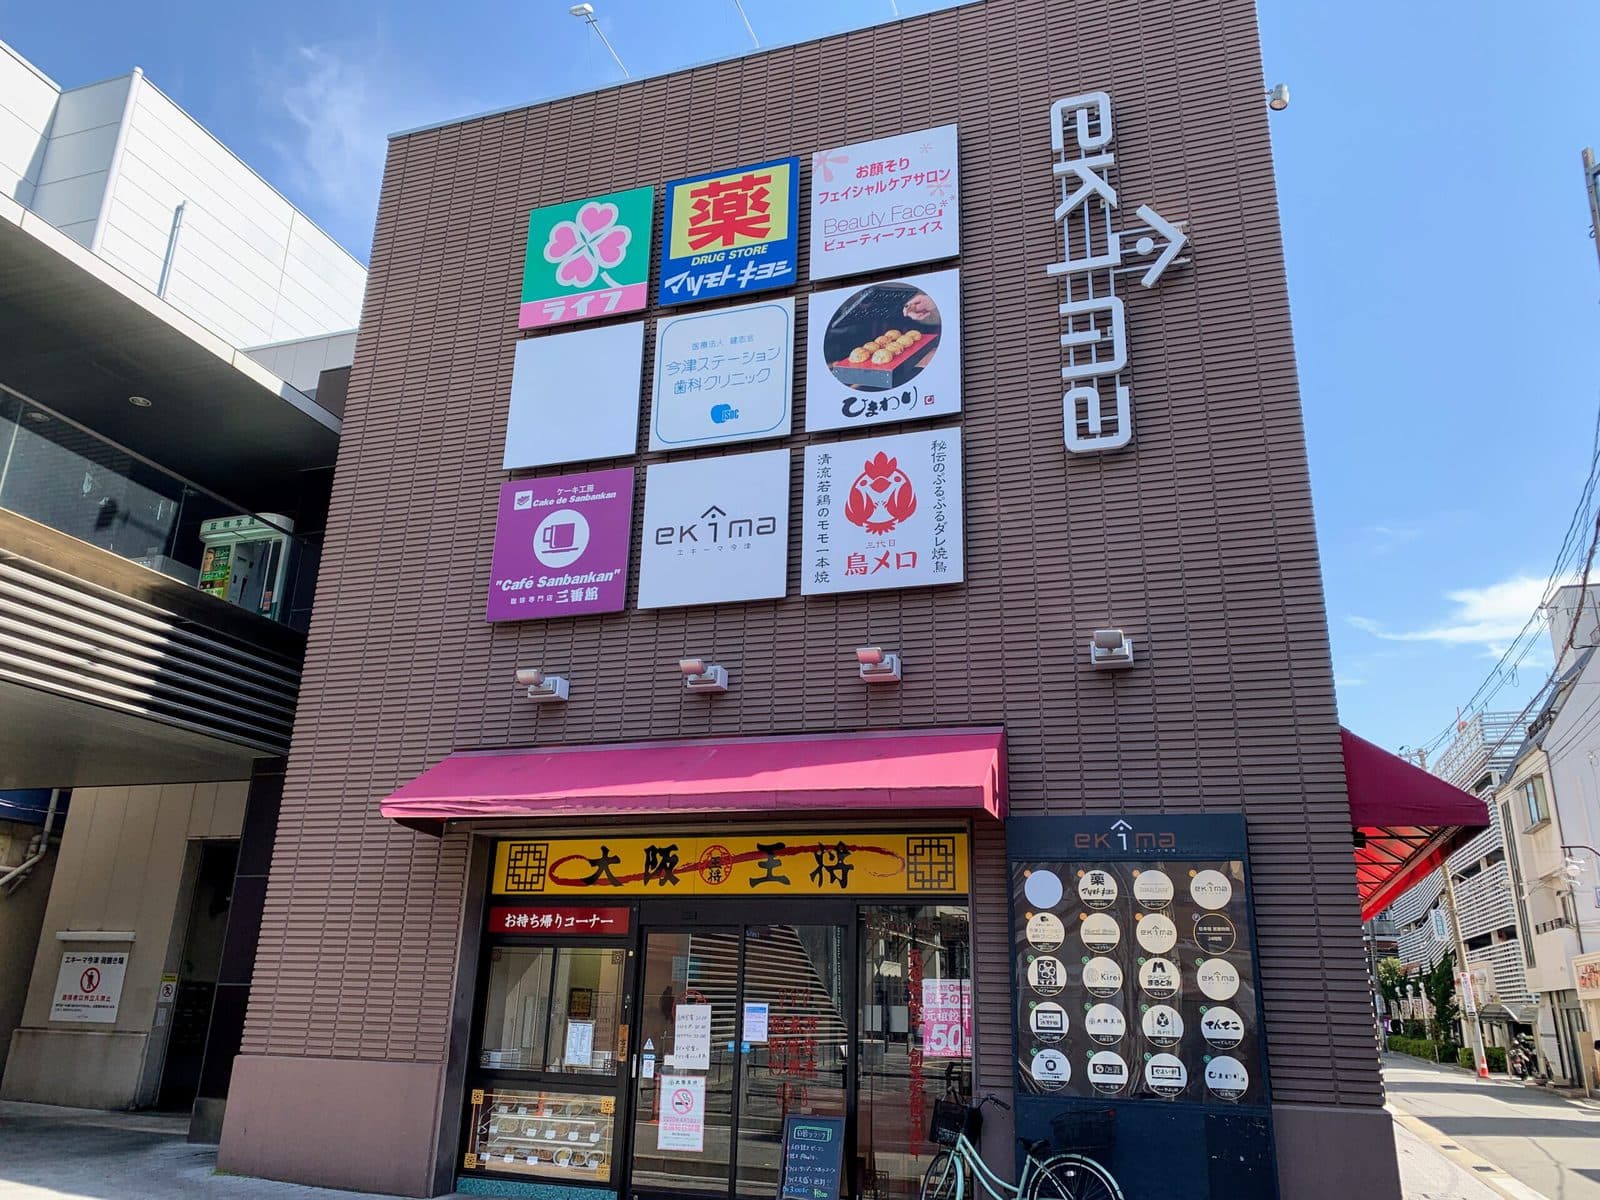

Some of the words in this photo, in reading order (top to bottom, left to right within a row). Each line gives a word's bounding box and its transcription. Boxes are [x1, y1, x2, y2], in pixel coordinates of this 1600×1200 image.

[856, 157, 910, 179] お顔そり
[818, 169, 951, 204] フェイシャルケアサロン
[688, 174, 772, 251] 薬
[823, 209, 886, 235] Beauty
[891, 202, 937, 223] Face
[824, 221, 943, 252] ビューティーフェイス
[691, 252, 726, 266] DRUG
[728, 244, 769, 260] STORE
[664, 260, 792, 296] マツモトキヨシ
[542, 291, 623, 321] ライフ
[665, 346, 781, 376] 今津ステーション
[673, 368, 771, 395] 歯科クリニック
[841, 386, 918, 418] ひまわり
[533, 498, 554, 508] Cake
[556, 497, 568, 505] de
[569, 491, 617, 504] Sanbankan
[556, 484, 595, 496] ケーキ工房
[655, 505, 776, 545] ekima
[814, 453, 833, 584] 清流若鶏のモモ一本焼
[845, 550, 918, 576] 鳥メロ
[555, 586, 599, 604] 三番館
[1074, 819, 1176, 851] ekima
[580, 841, 854, 888] 大阪王将
[1090, 873, 1105, 885] 薬
[1194, 882, 1228, 893] ekima
[504, 913, 614, 928] お持ち帰りコーナー
[1140, 925, 1173, 936] ekima
[1201, 971, 1235, 982] ekima
[929, 1023, 966, 1052] 50
[1204, 1019, 1241, 1031] てんてこ
